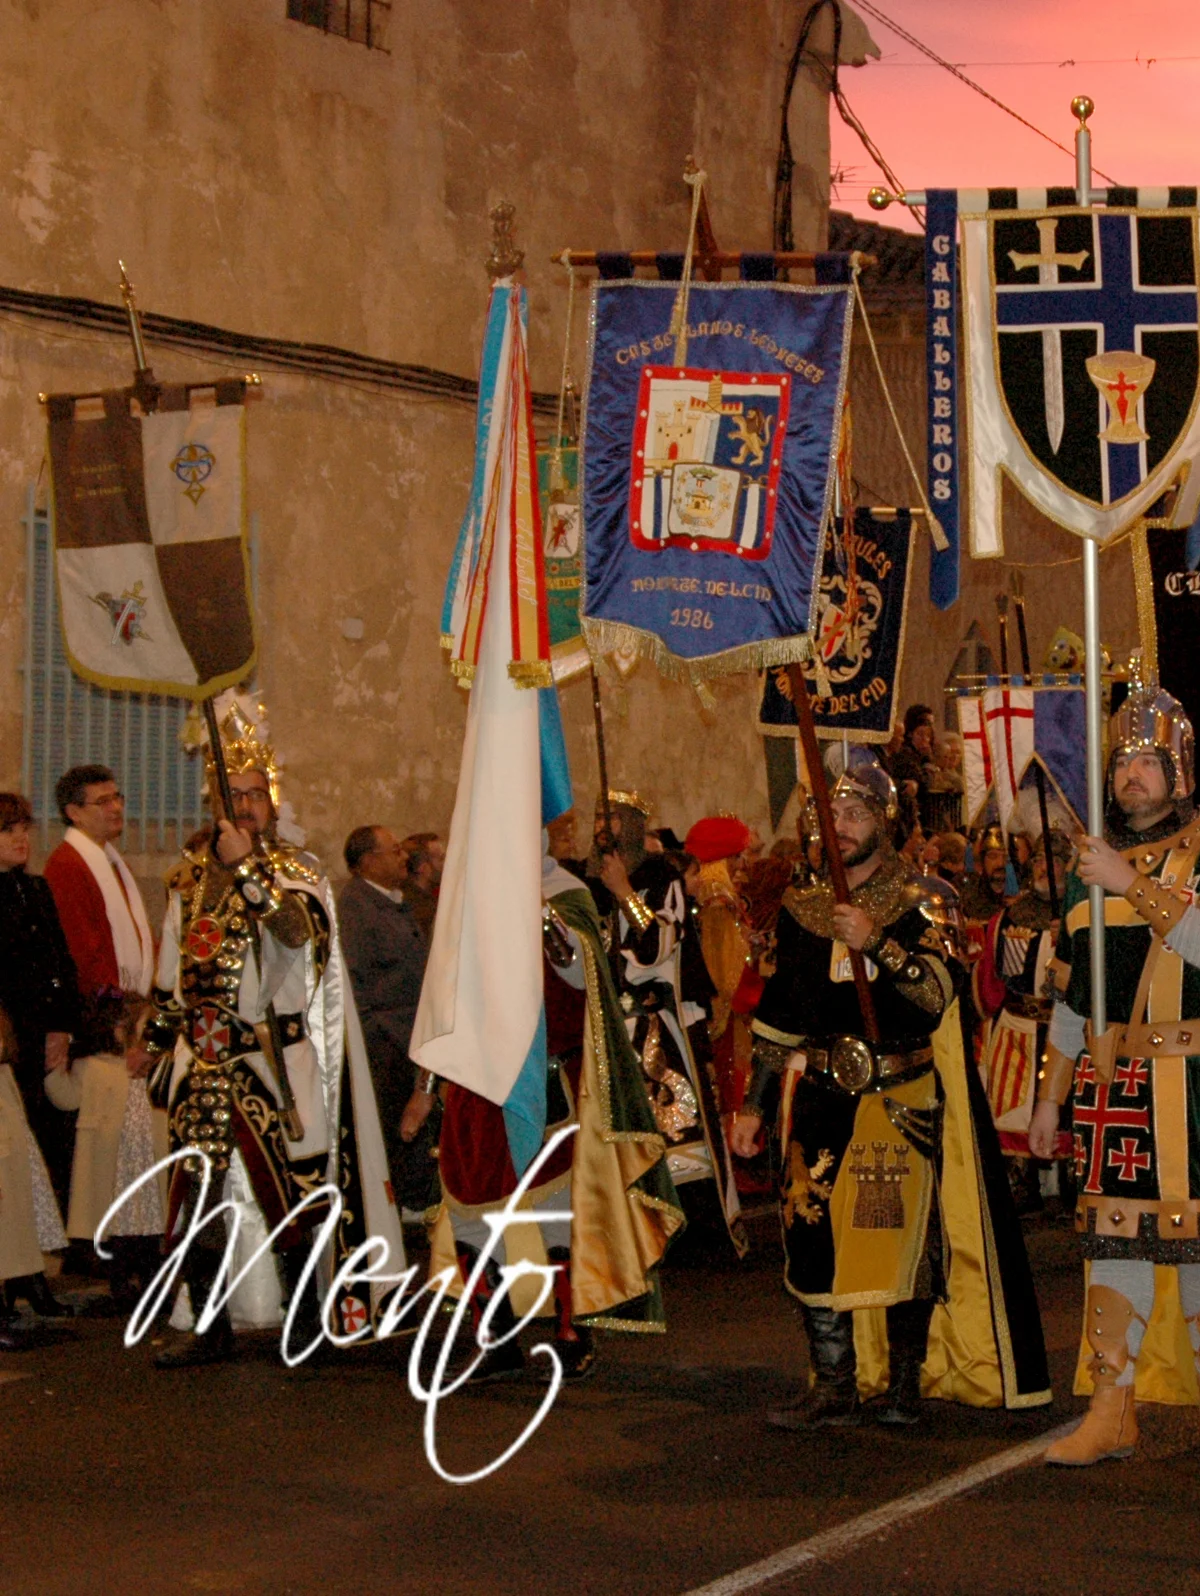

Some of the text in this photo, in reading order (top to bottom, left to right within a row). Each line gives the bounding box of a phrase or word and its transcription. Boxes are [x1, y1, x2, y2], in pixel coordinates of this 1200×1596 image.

[669, 607, 715, 630] 1986
[827, 693, 860, 716] DEL
[860, 676, 888, 708] CID
